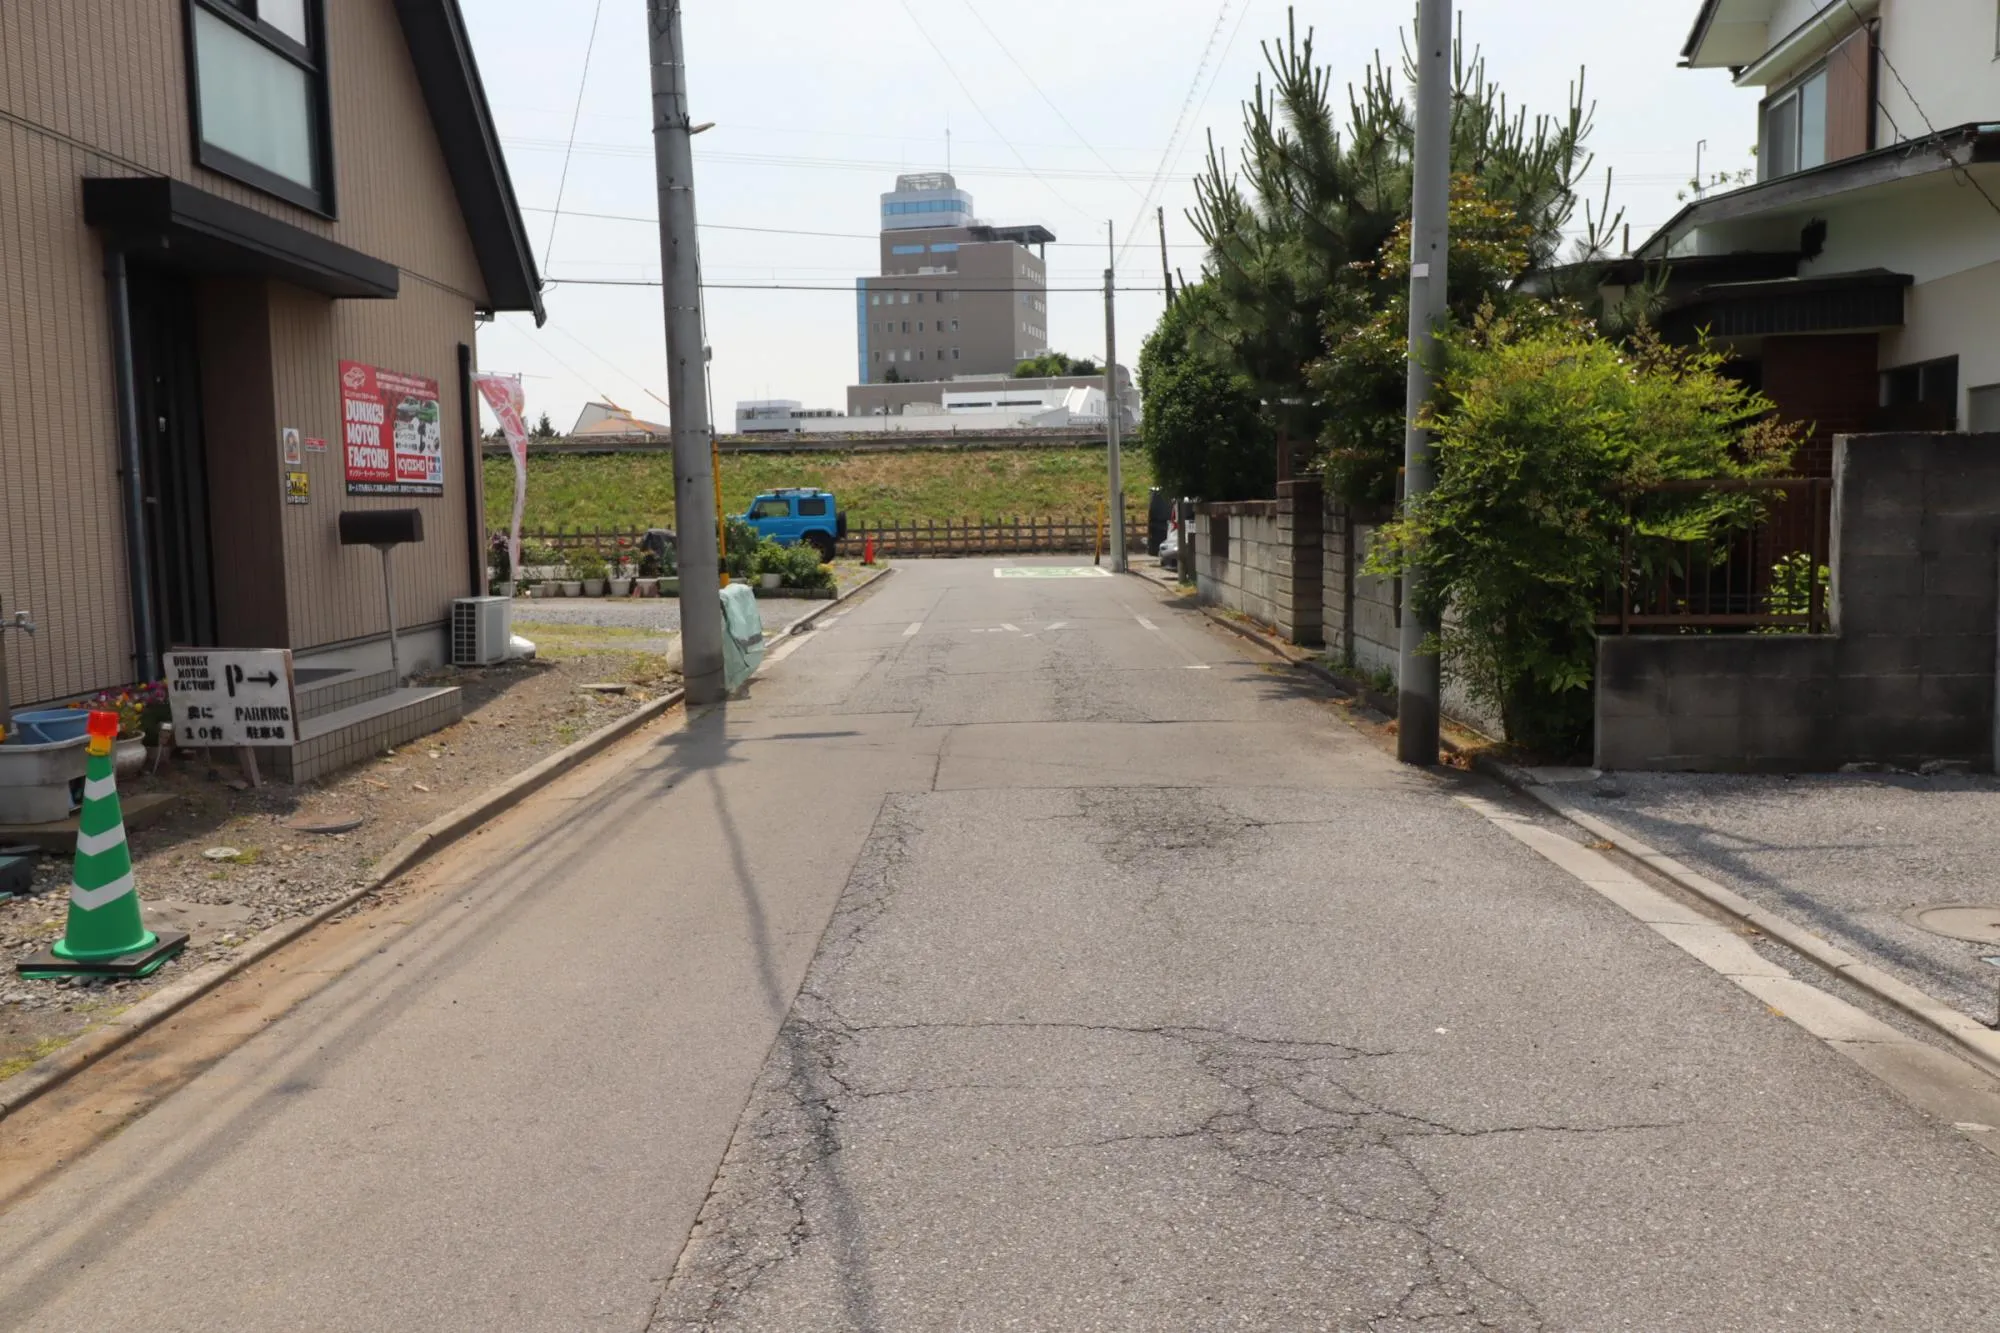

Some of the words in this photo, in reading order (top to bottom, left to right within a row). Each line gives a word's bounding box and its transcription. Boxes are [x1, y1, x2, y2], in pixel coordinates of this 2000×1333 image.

[347, 422, 380, 446] MOTOR
[348, 446, 389, 469] FACTORY
[178, 668, 208, 678] MOTOR
[225, 664, 243, 697] P
[173, 680, 216, 691] FACTORY
[235, 706, 289, 721] PARKING
